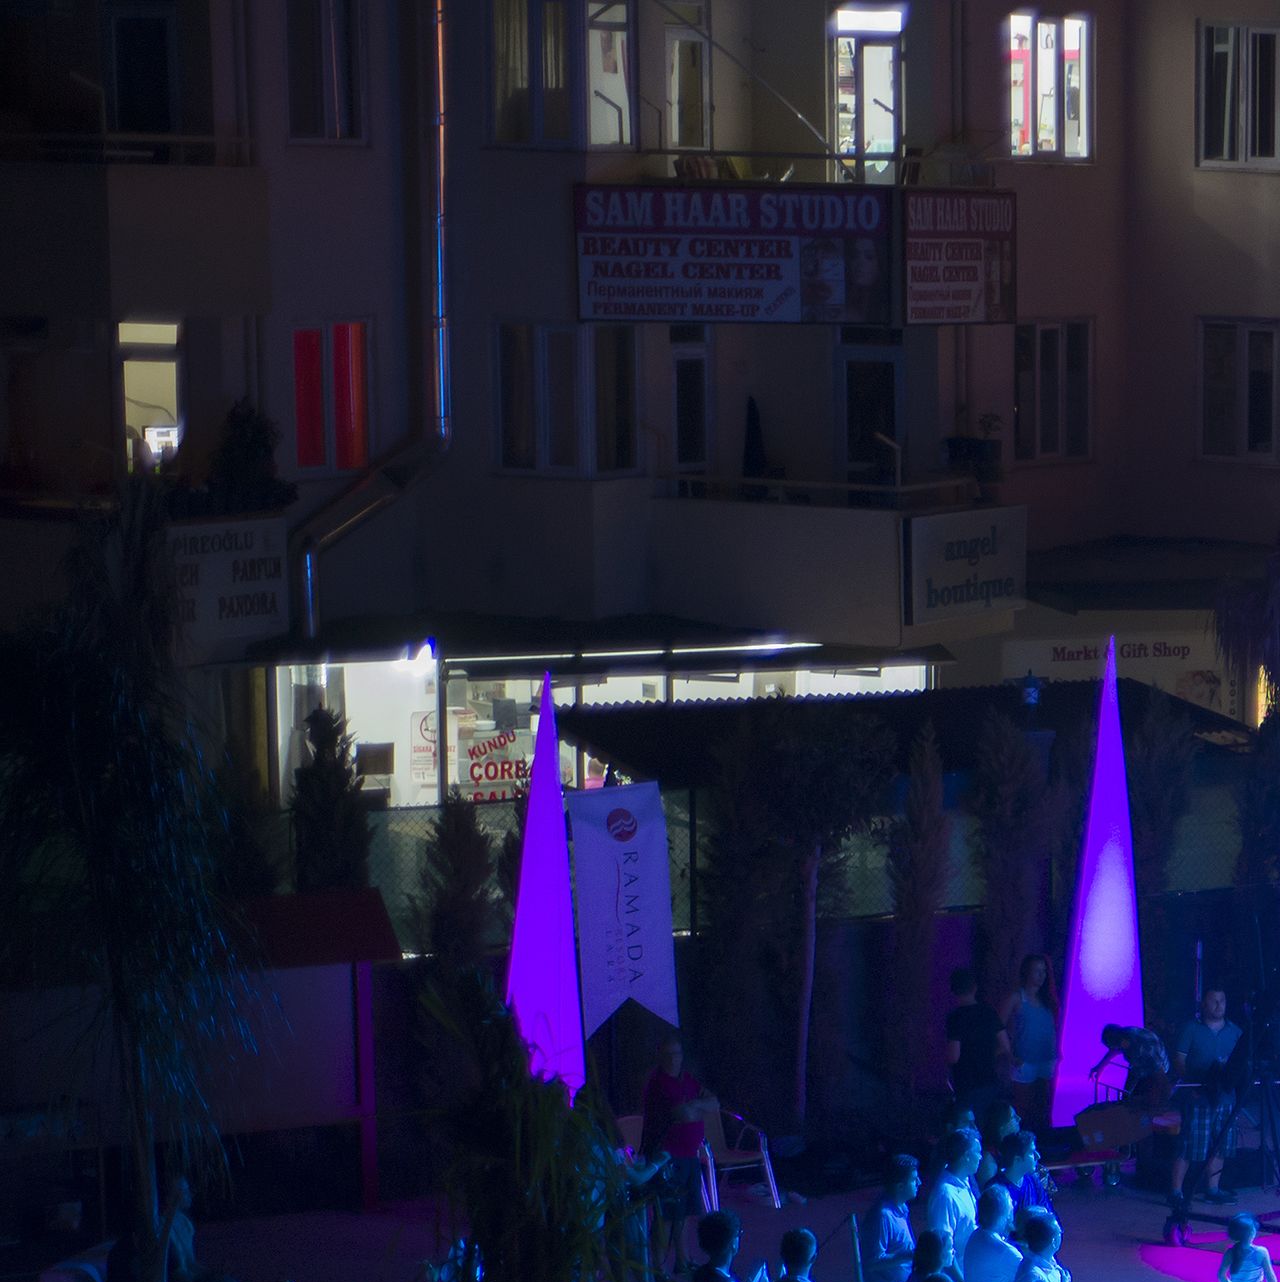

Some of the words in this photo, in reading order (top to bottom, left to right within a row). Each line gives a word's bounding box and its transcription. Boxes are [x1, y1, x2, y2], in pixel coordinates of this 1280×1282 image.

[586, 190, 655, 227] SAM
[664, 192, 750, 228] HAAR
[759, 193, 880, 230] STUDIO
[582, 236, 681, 257] BEAUTY
[688, 238, 794, 258] CENTER
[592, 261, 674, 279] NAGEL
[682, 263, 782, 280] CENTER
[587, 281, 699, 300] Перманентный
[708, 287, 764, 300] макияж
[593, 302, 686, 317] PERMANENT
[691, 303, 760, 318] MAKE-UP
[944, 526, 998, 566] angel
[926, 573, 1015, 608] boutique
[1052, 645, 1098, 661] Markt
[1120, 643, 1149, 658] Gift
[1153, 641, 1190, 659] Shop
[467, 729, 517, 760] KUNDU
[469, 760, 530, 787] ÇORB
[622, 851, 644, 984] RAMADA
